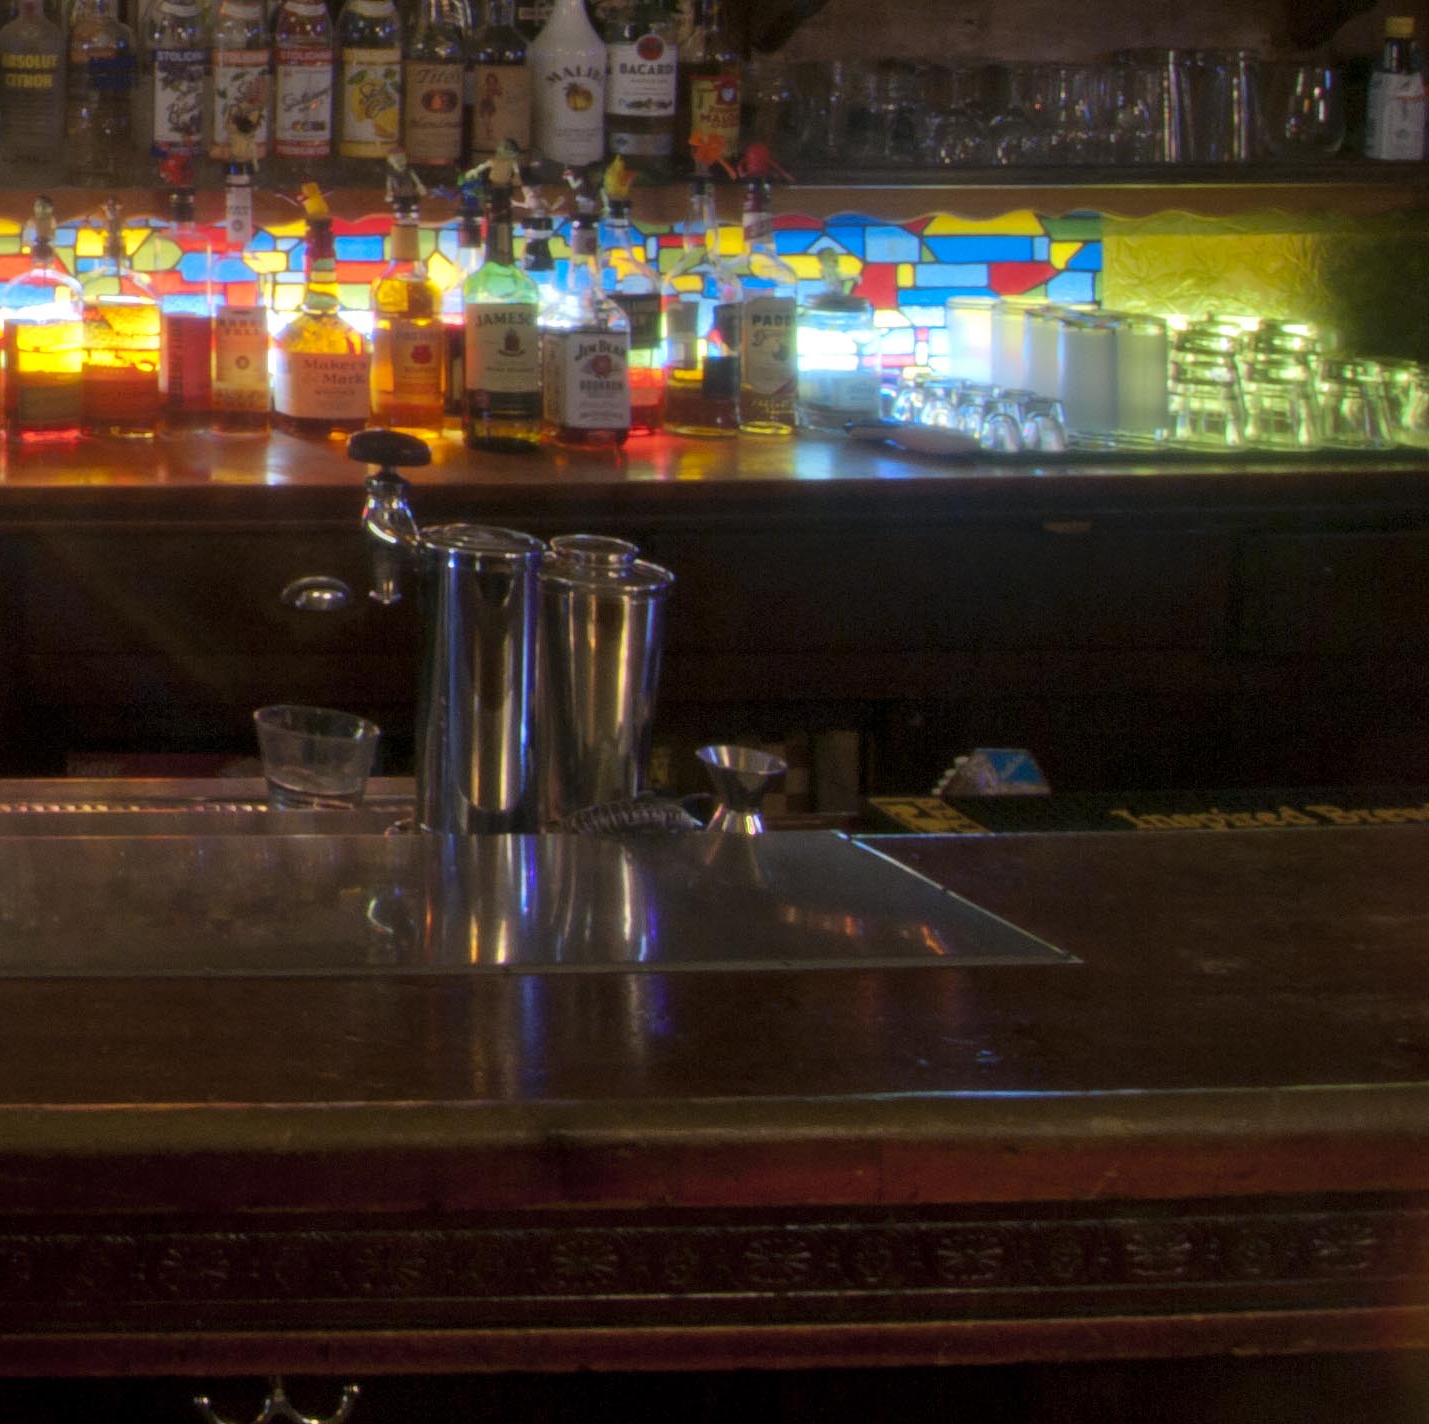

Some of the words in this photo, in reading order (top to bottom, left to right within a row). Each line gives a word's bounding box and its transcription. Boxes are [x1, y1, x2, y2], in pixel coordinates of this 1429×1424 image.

[1, 54, 58, 69] ABSOLUT
[476, 312, 538, 326] JAMES
[751, 313, 796, 326] PADD
[323, 373, 367, 385] Mark
